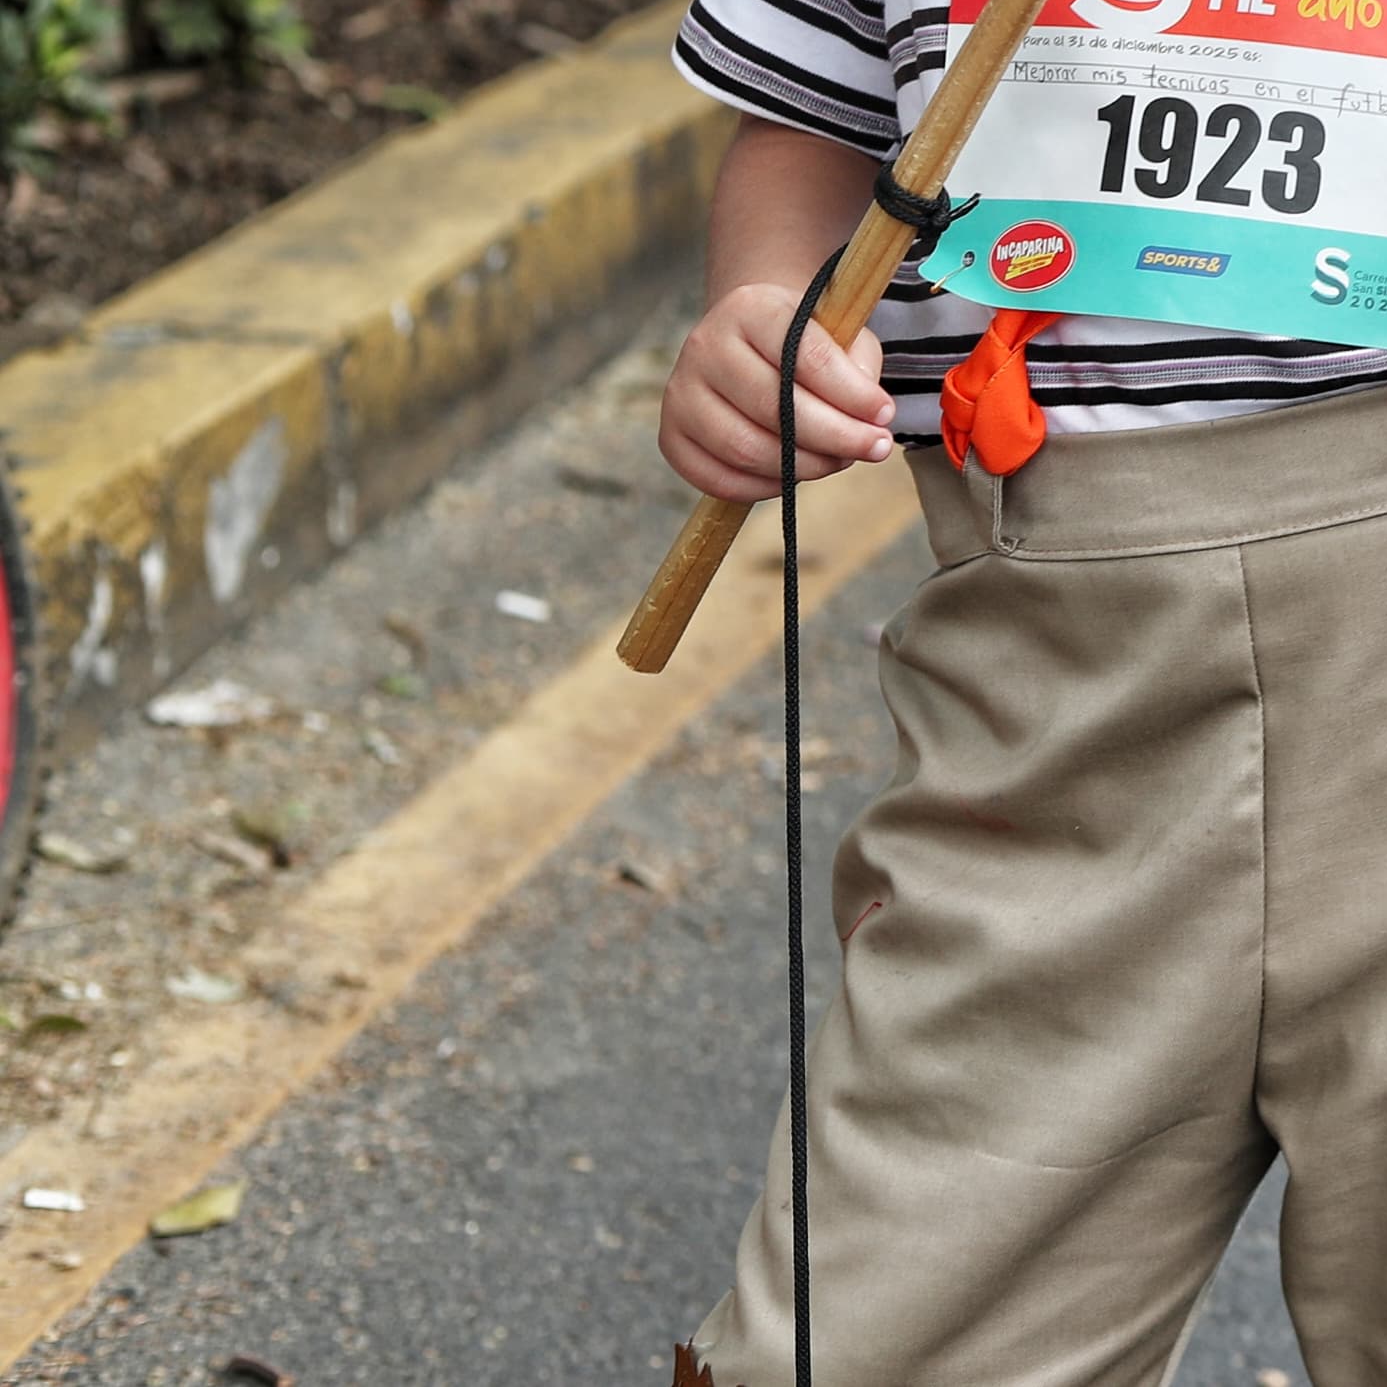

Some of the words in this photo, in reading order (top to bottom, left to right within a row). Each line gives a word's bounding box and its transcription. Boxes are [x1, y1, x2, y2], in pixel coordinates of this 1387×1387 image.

[1022, 35, 1050, 49] para
[1053, 35, 1065, 47] el
[1068, 36, 1085, 47] 31
[1089, 36, 1108, 49] de
[1112, 37, 1185, 55] diciembre
[1190, 44, 1239, 60] 2025
[1092, 69, 1128, 85] mis
[1254, 81, 1281, 99] en
[1296, 88, 1315, 105] el
[1097, 94, 1327, 214] 1923
[996, 236, 1065, 262] INCAPARINA
[1142, 251, 1221, 272] SPORTS&
[1352, 282, 1373, 295] San
